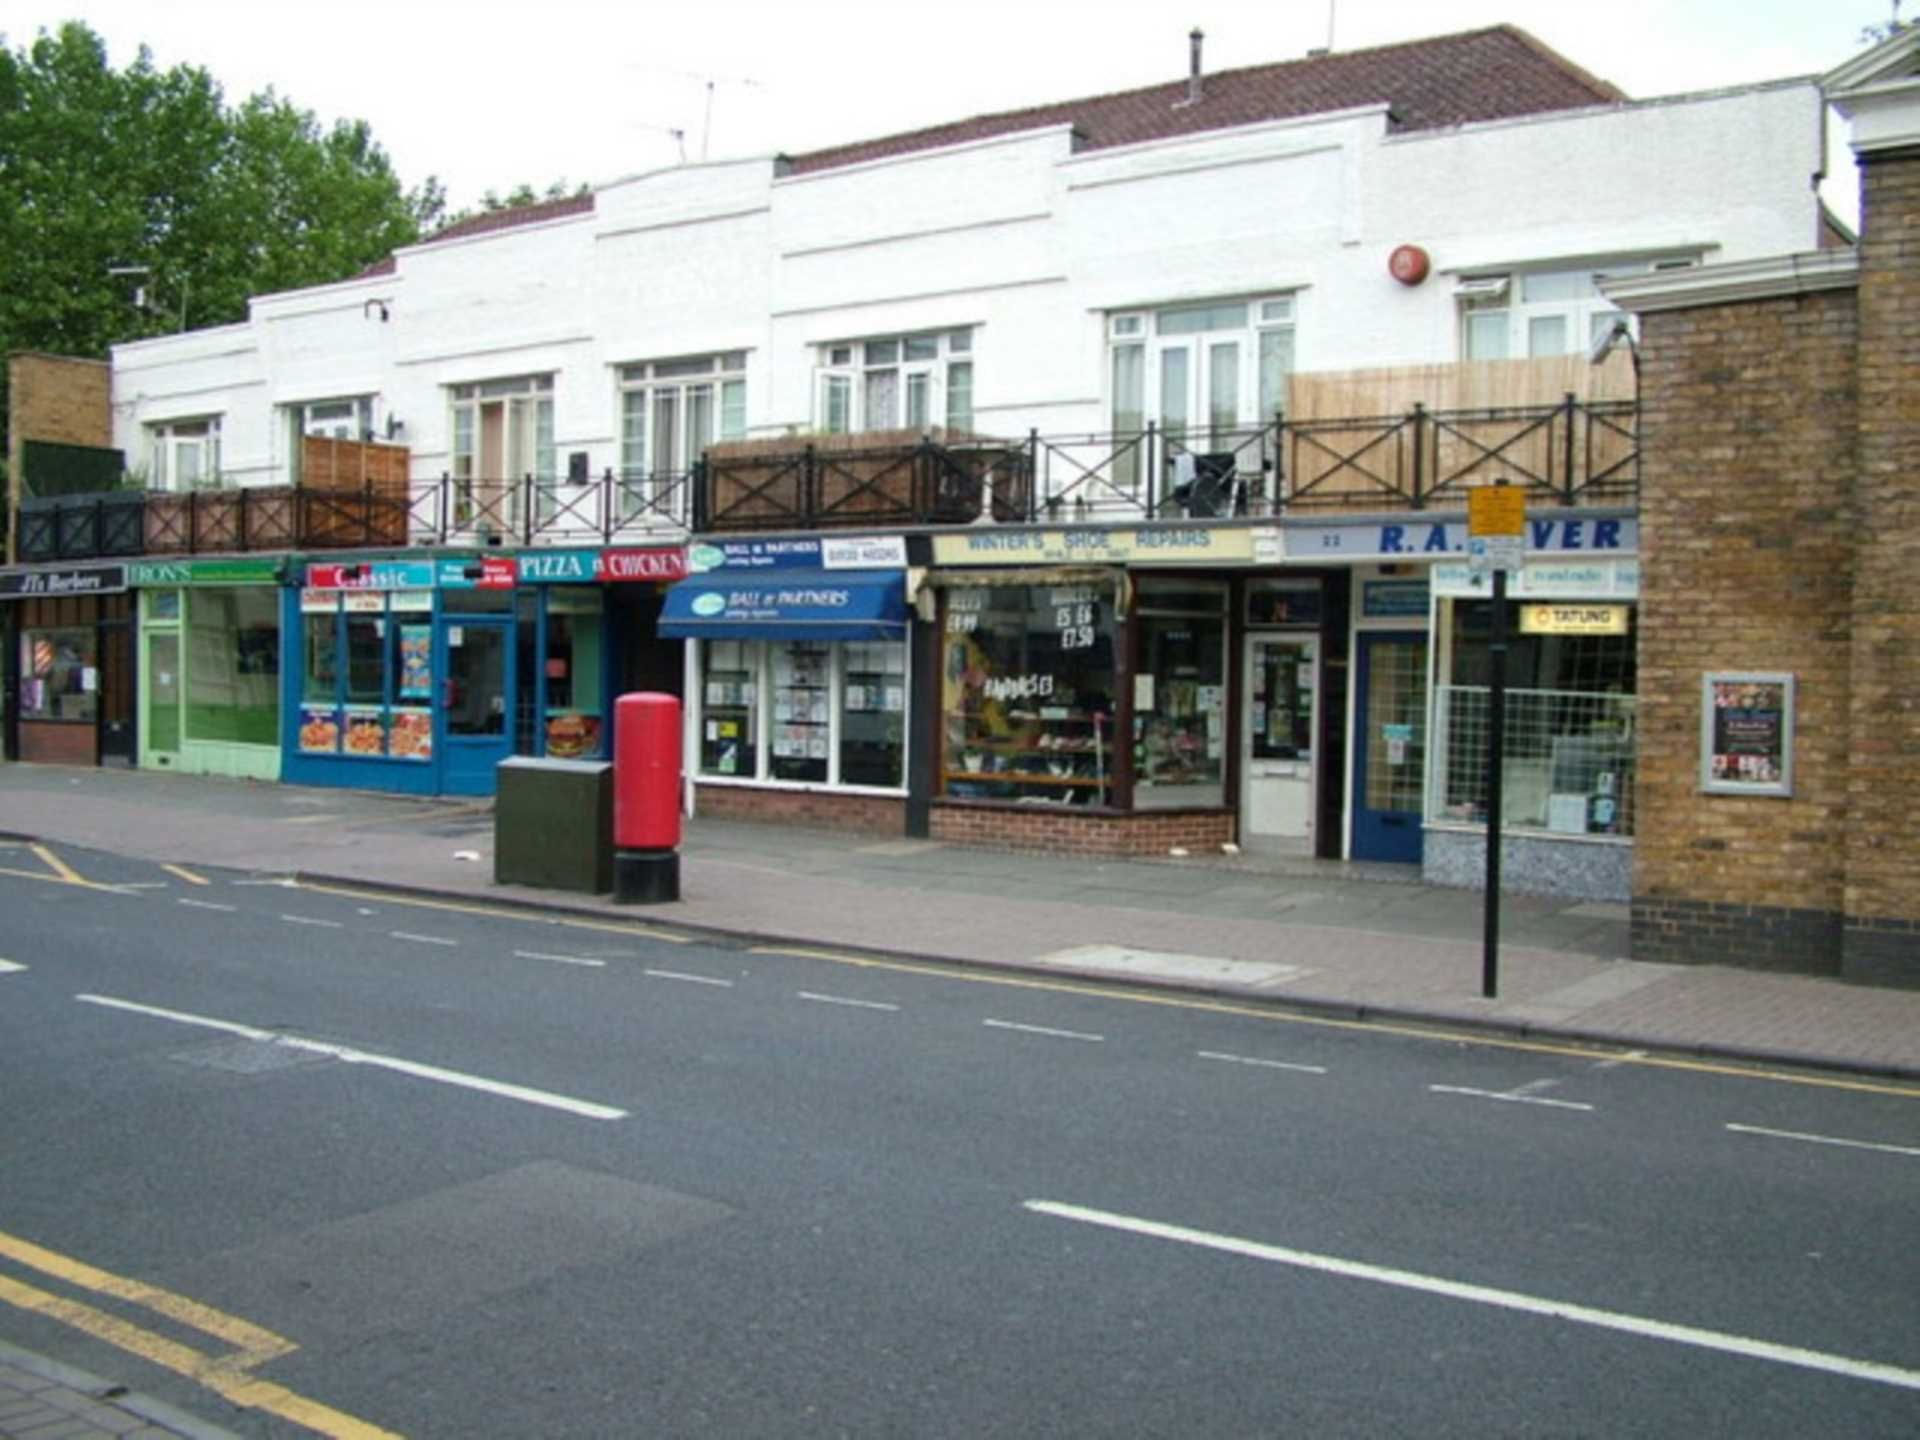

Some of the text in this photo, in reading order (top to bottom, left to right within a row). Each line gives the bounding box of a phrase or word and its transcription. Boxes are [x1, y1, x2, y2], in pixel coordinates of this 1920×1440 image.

[1064, 531, 1110, 549] SHOE
[1136, 529, 1210, 548] REPAIRS
[521, 554, 582, 577] PIZZA
[609, 553, 681, 577] CHICKEN
[777, 589, 849, 607] PARTNERS
[1552, 610, 1611, 623] TATUNG
